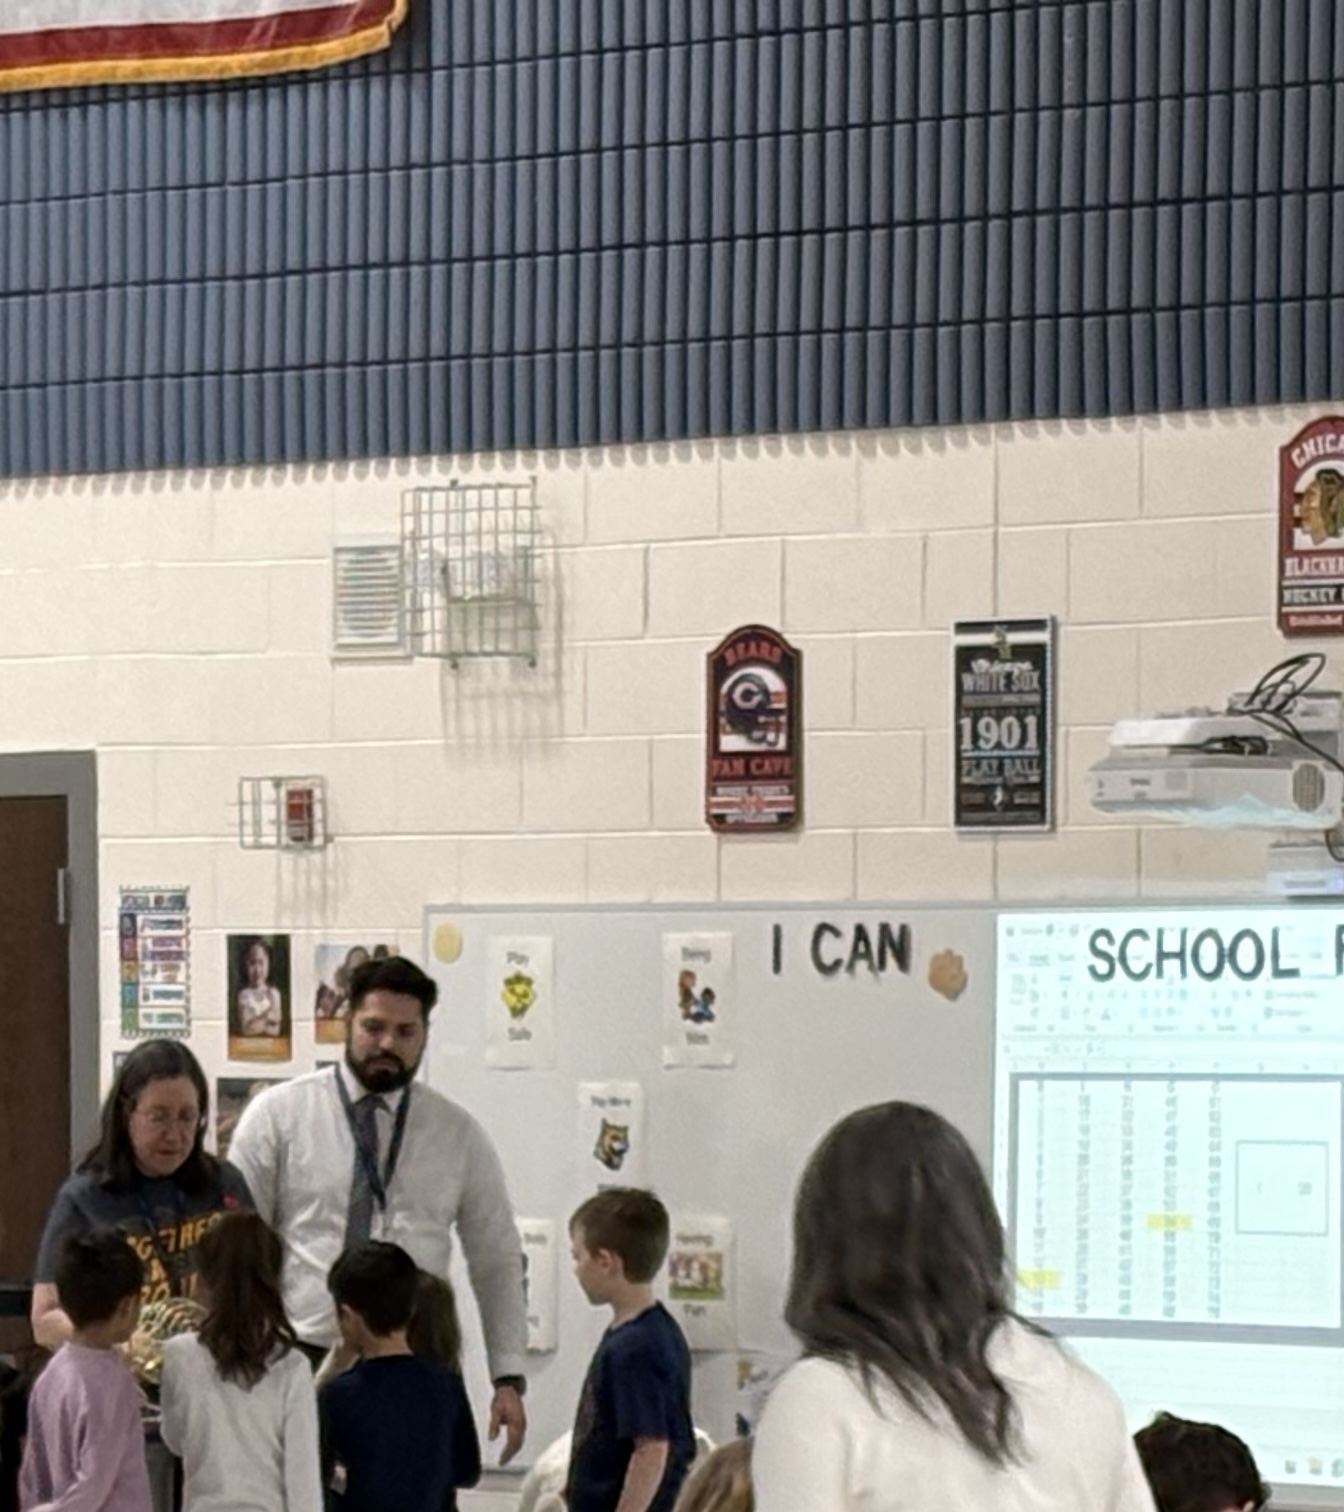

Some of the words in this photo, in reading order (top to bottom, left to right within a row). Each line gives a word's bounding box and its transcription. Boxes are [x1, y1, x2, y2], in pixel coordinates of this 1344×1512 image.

[724, 641, 782, 666] BEARS
[961, 672, 1007, 692] WHITE
[1011, 671, 1041, 692] SOX
[960, 715, 1038, 750] 1901
[712, 759, 745, 776] FAN
[750, 757, 793, 776] CAVE
[962, 759, 999, 776] PLAY
[1003, 758, 1041, 775] BALL
[772, 924, 782, 975] I
[811, 922, 912, 978] CAN
[1088, 926, 1301, 982] SCHOOL
